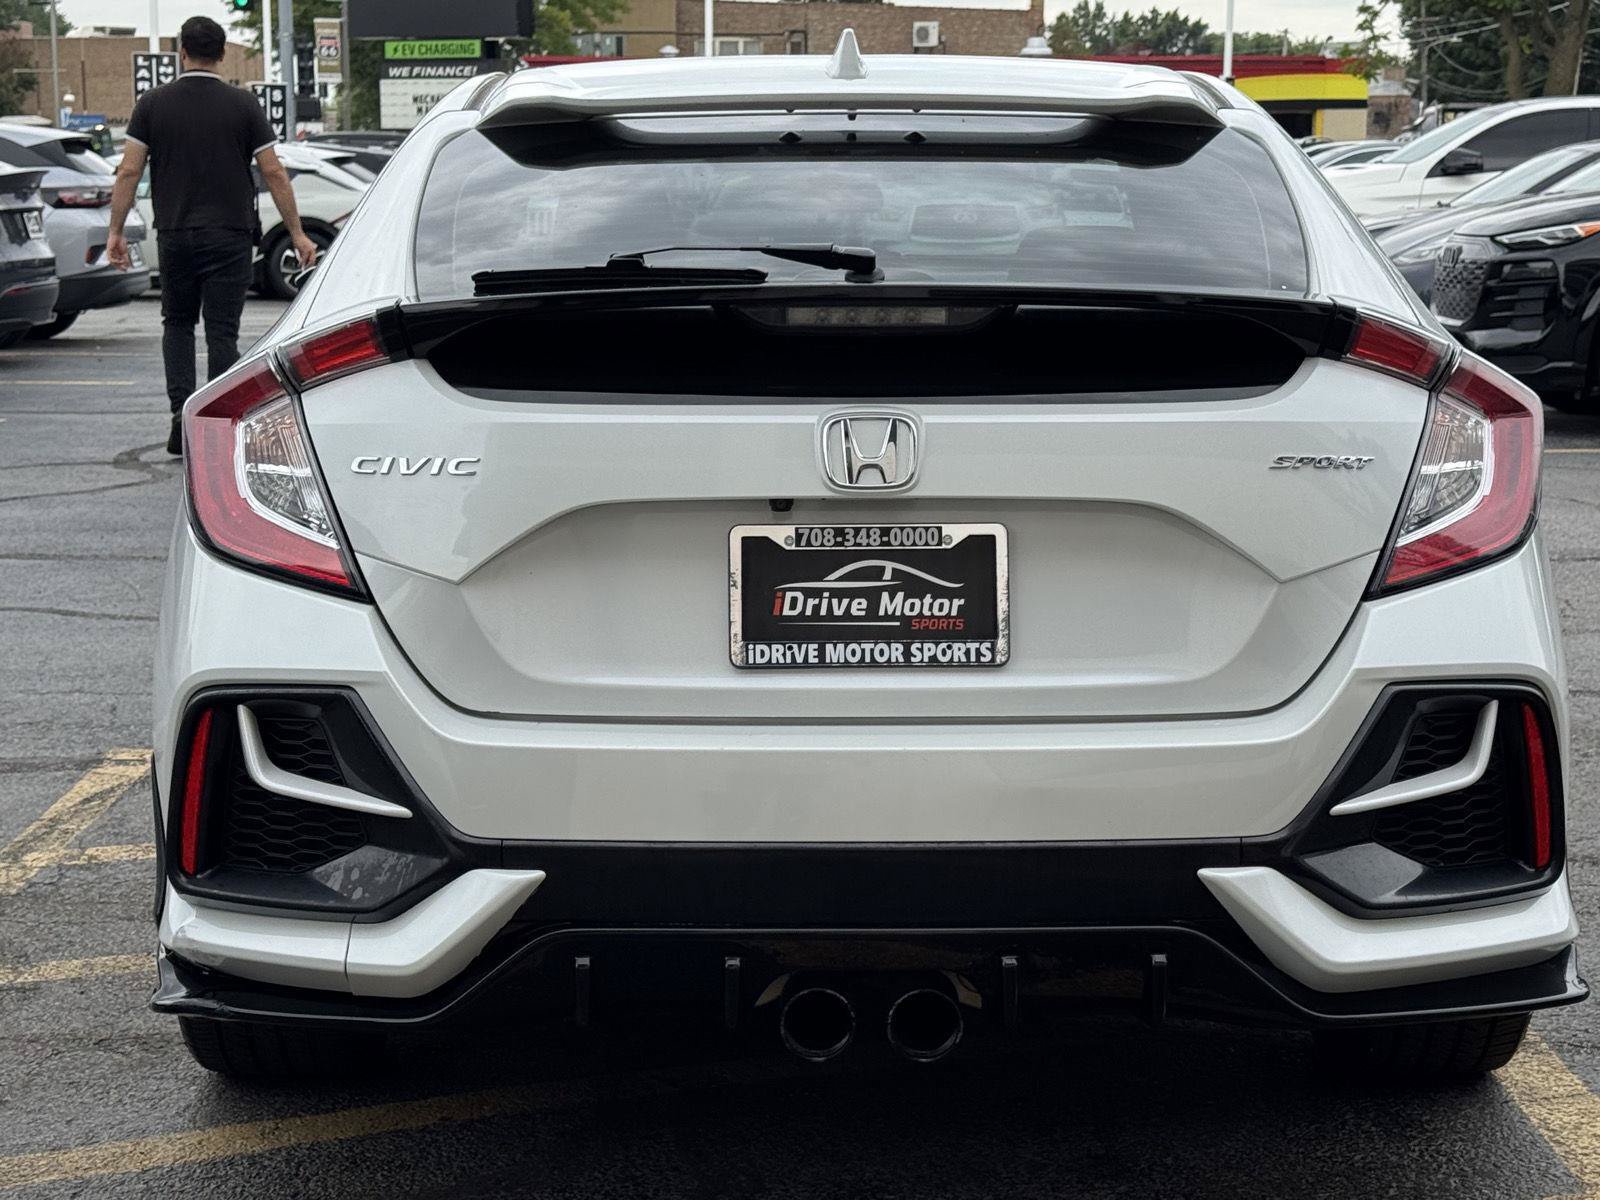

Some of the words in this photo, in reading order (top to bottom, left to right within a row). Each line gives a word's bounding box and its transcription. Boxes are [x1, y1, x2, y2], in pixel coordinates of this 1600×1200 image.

[320, 45, 337, 57] 66
[401, 42, 416, 56] EV
[418, 42, 475, 56] CHARGING
[388, 66, 411, 77] WE
[412, 65, 478, 77] FINANCE!
[350, 456, 481, 477] CIVIC
[1268, 454, 1375, 470] SPORT
[798, 527, 939, 547] 708-348-0000
[772, 591, 868, 617] iDrive
[878, 590, 965, 617] Motor
[911, 618, 965, 631] SPORTS
[747, 643, 819, 664] iDRIVE
[825, 643, 905, 664] MOTOR
[910, 642, 993, 663] SPORTS
